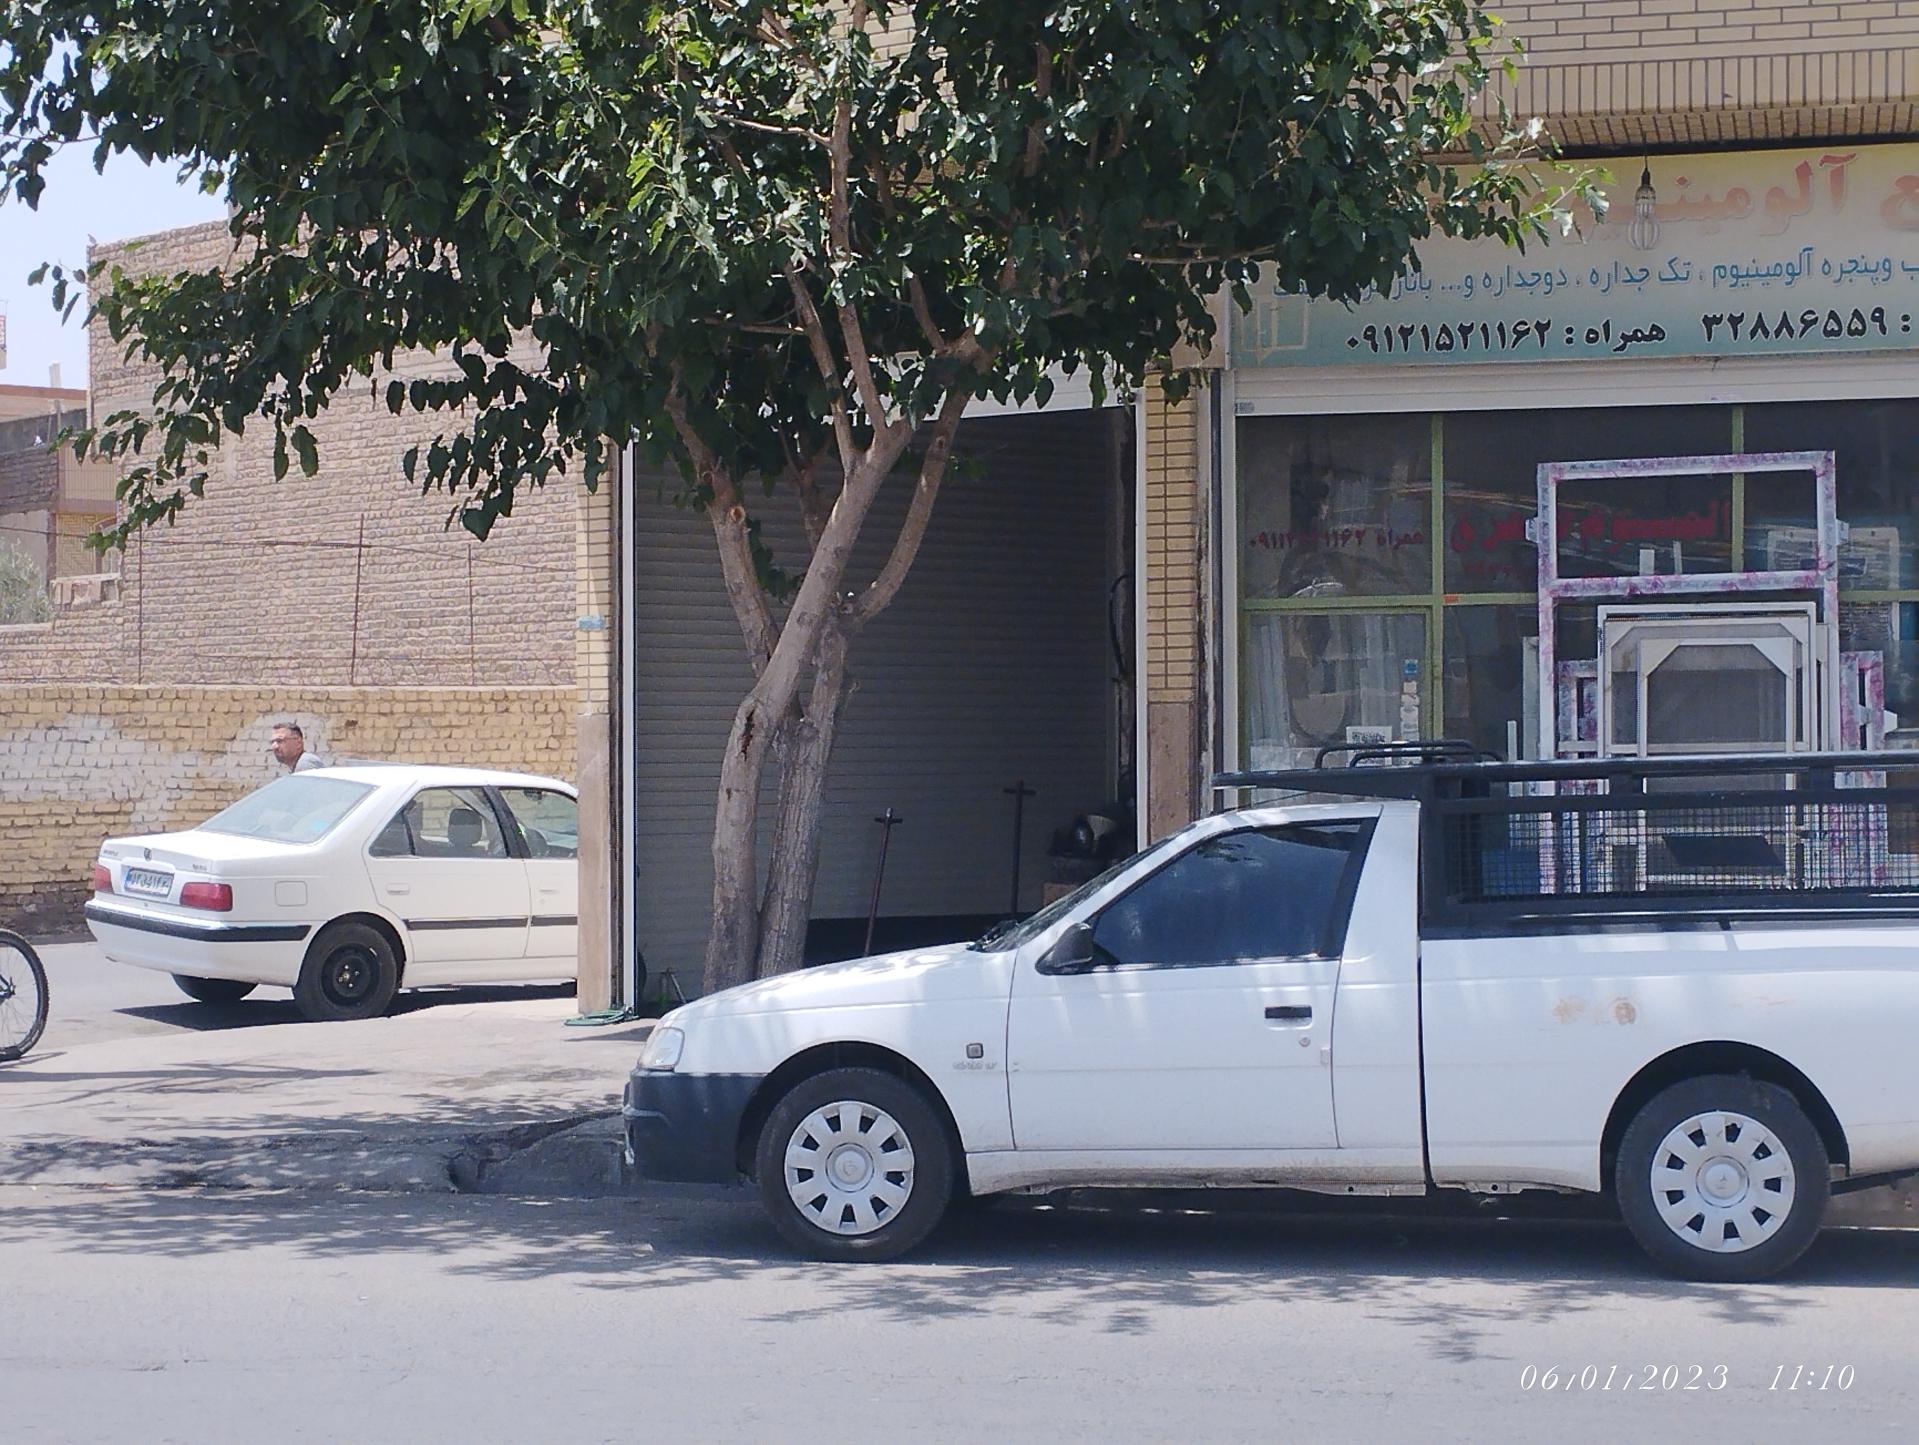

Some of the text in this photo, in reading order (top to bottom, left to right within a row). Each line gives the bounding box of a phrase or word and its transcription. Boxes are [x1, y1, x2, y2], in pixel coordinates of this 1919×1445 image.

[1589, 260, 1650, 293] جداره
[1346, 318, 1552, 353] ۰۹۱۲۱۵۲۱۱۶۲
[1701, 305, 1888, 343] ۳۲۸۸۶۵۵۹
